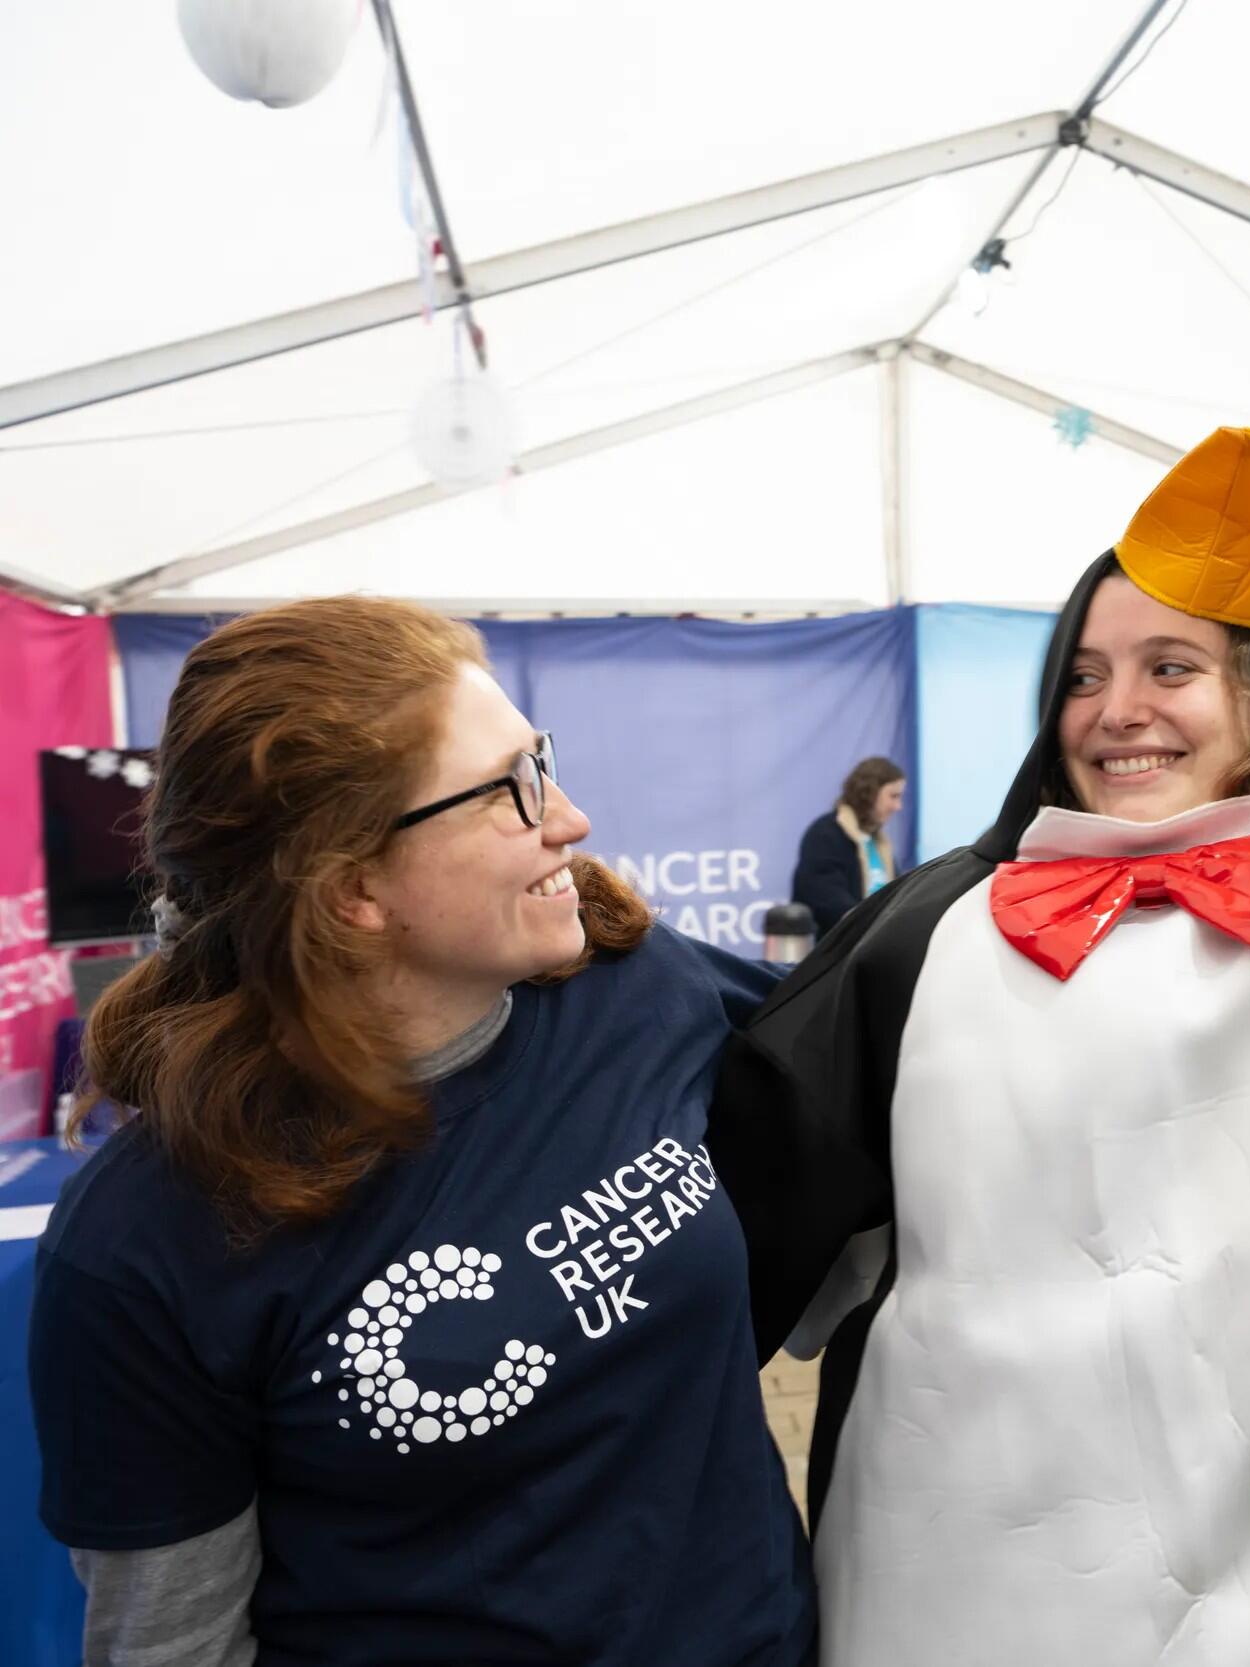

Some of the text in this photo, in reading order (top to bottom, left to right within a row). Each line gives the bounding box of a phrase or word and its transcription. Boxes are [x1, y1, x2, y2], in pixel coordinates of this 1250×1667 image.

[613, 849, 761, 897] NCER
[525, 1137, 693, 1259] CANCER
[549, 1144, 718, 1302] RESEARCH
[575, 1275, 649, 1339] UK
